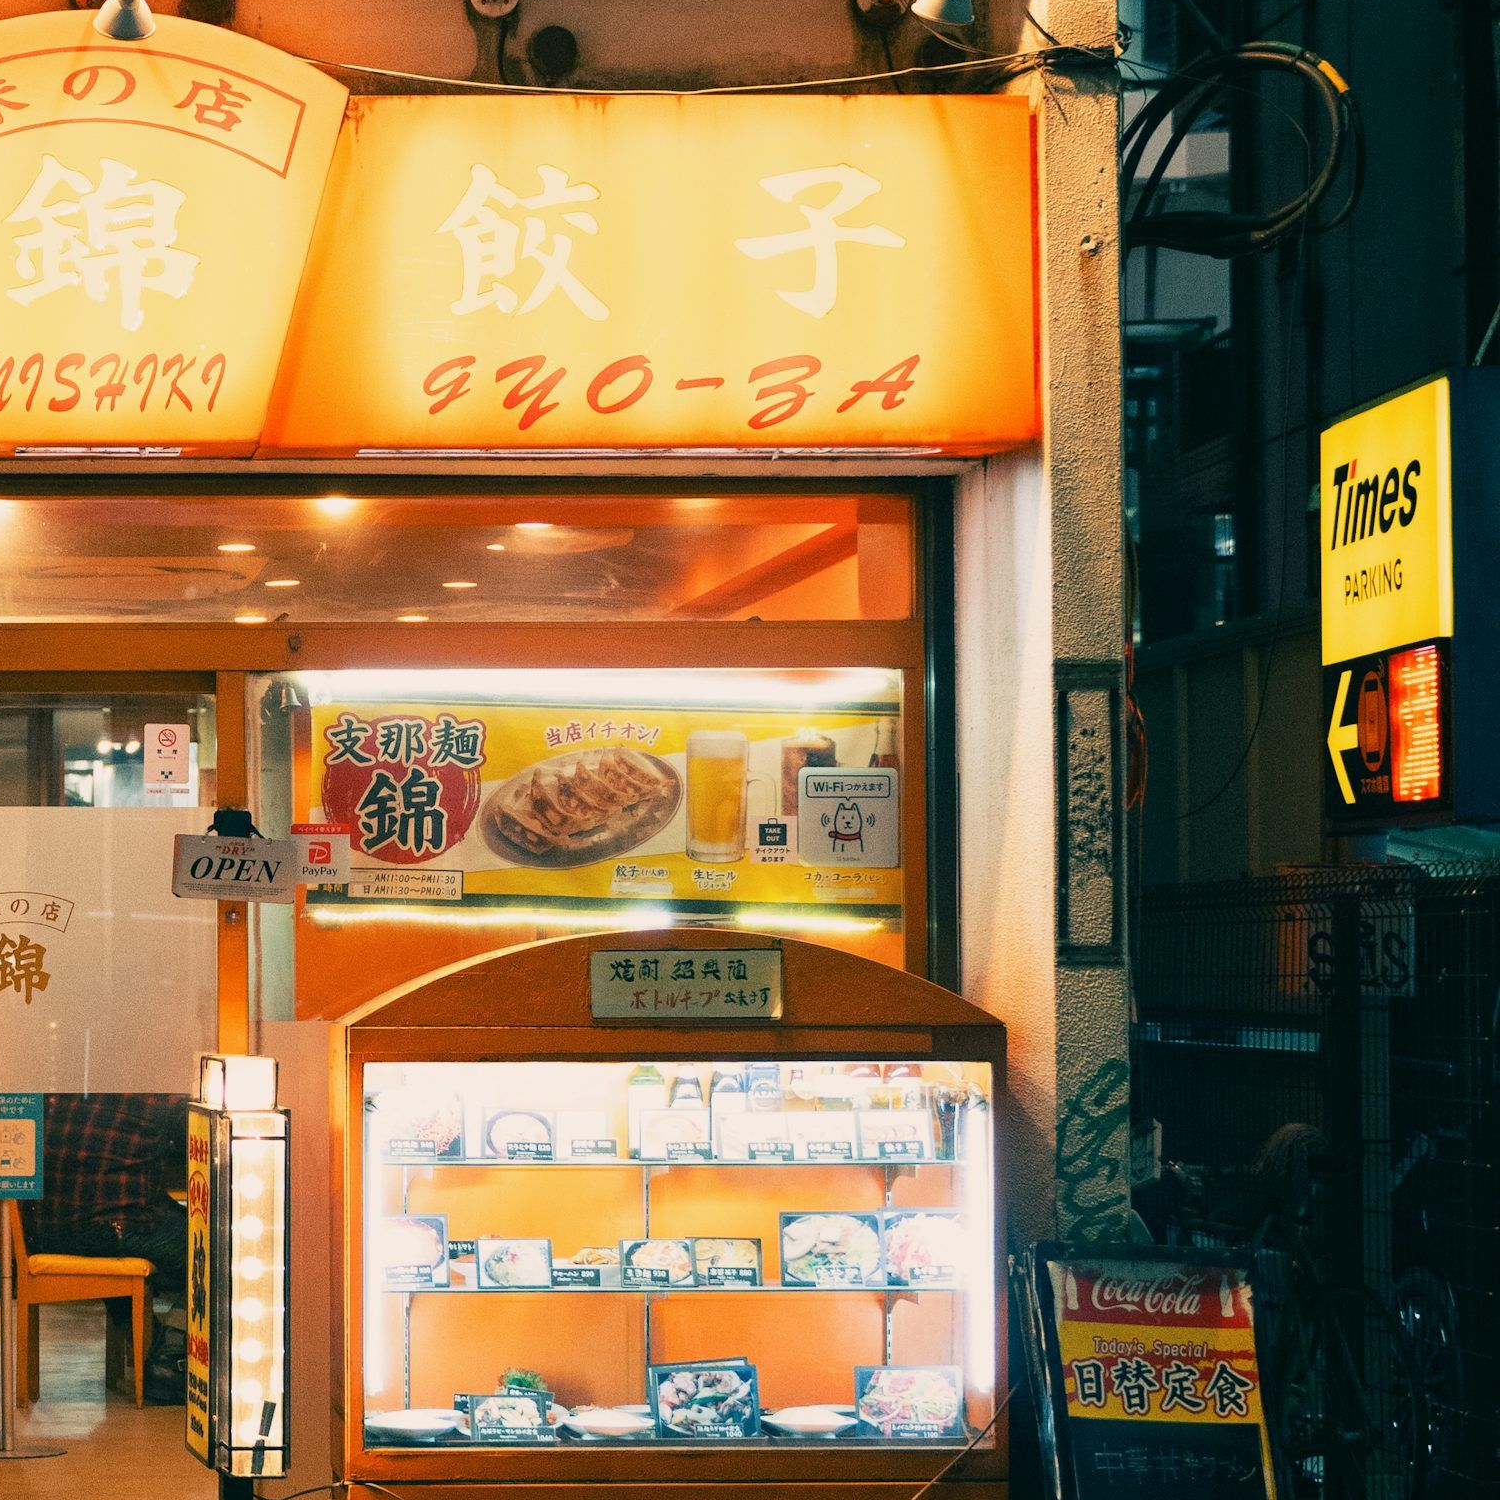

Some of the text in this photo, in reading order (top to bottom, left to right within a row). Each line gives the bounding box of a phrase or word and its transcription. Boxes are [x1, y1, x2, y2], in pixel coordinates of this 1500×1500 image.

[1, 153, 202, 332] 錦
[436, 162, 908, 321] 餃子
[423, 354, 921, 430] GYO-ZA
[1331, 458, 1422, 552] Times
[1344, 558, 1403, 606] PARKING
[327, 716, 485, 766] 支那麺
[357, 770, 446, 854] 錦
[190, 856, 282, 884] OPEN
[302, 866, 338, 877] PayPay
[693, 869, 737, 881] 生ビール
[609, 958, 660, 982] 焼酎
[1093, 1336, 1208, 1359] Today's Special
[1073, 1358, 1254, 1415] 日替定食
